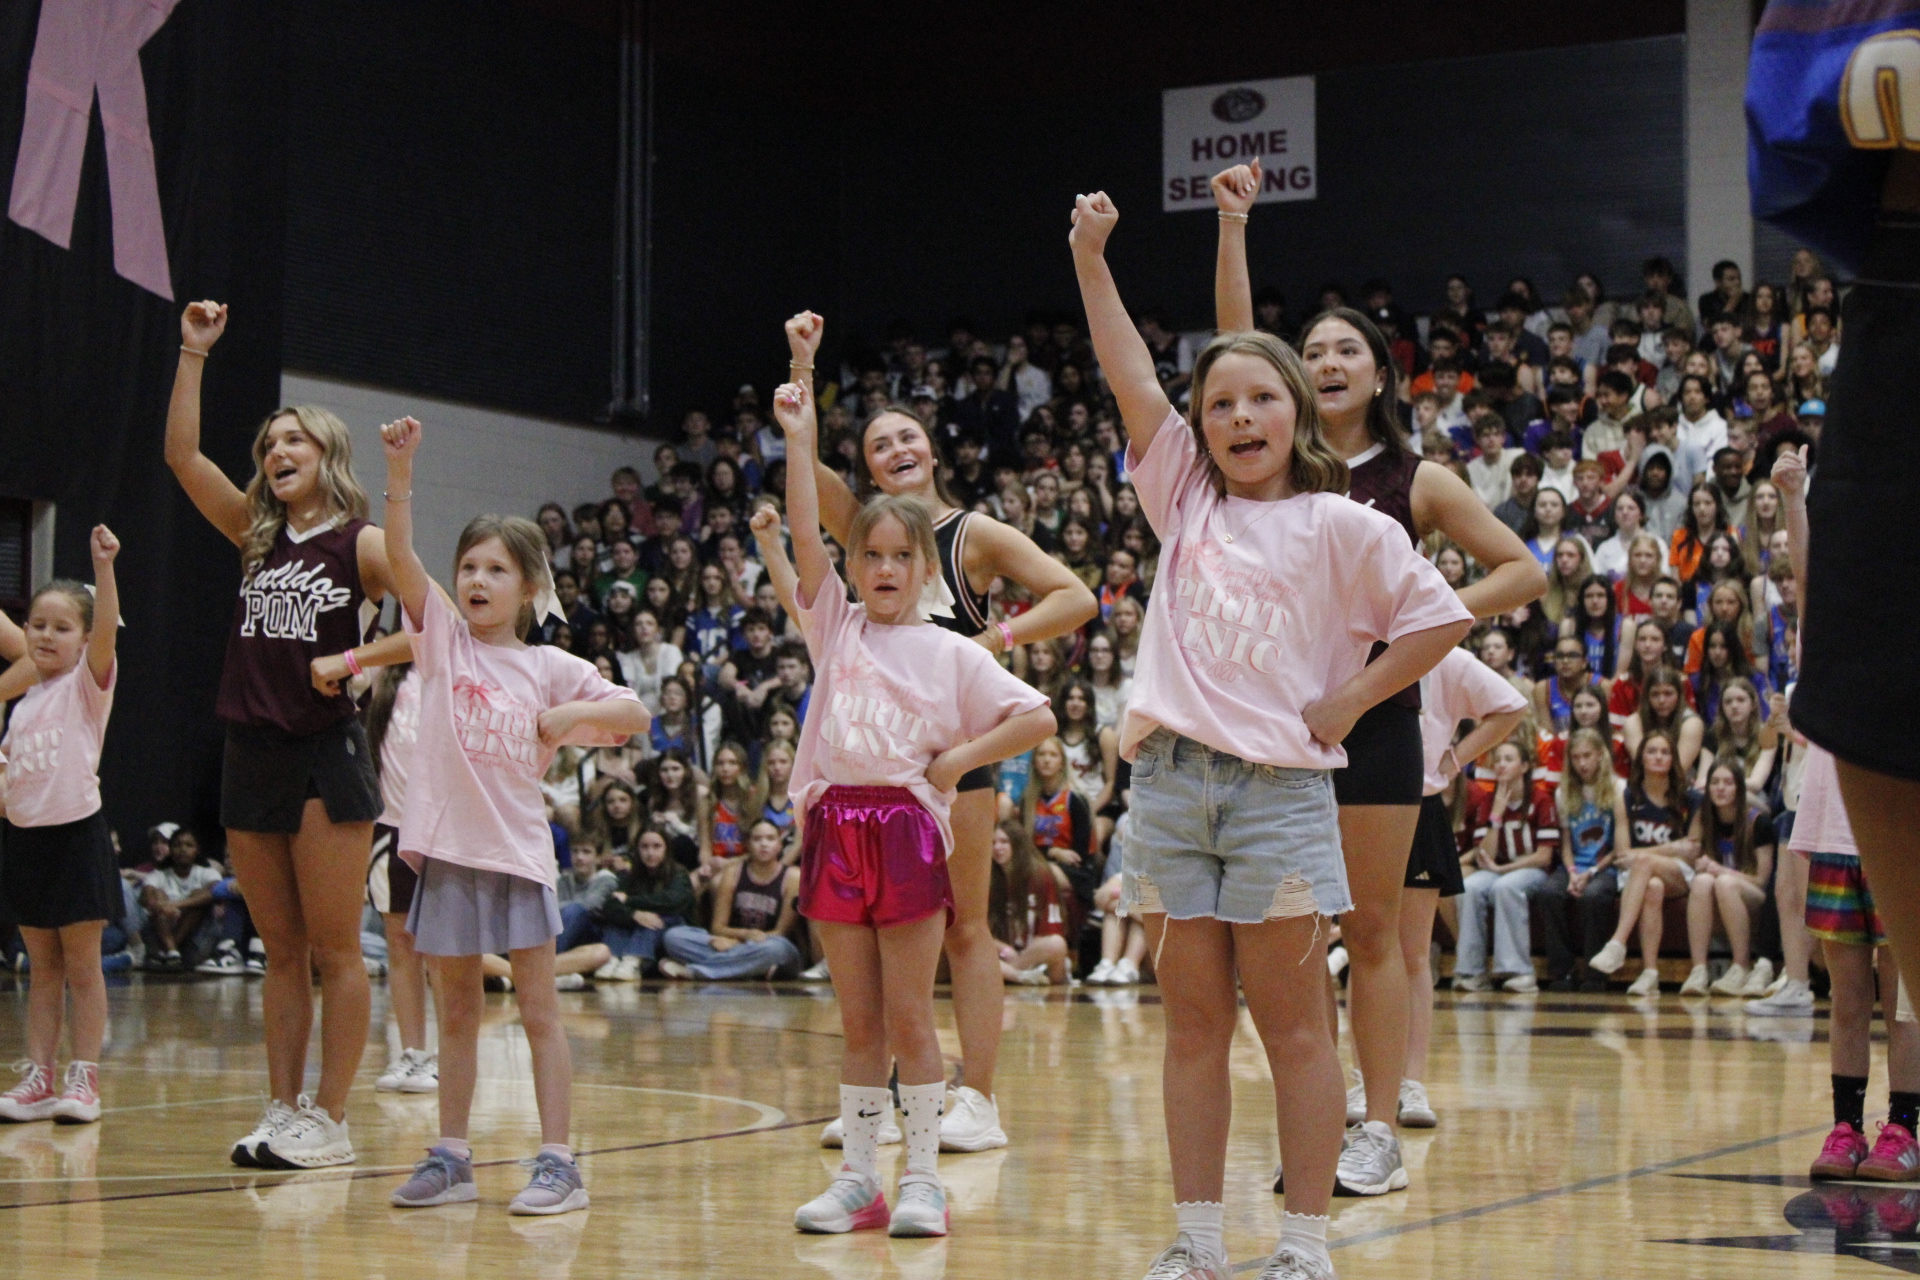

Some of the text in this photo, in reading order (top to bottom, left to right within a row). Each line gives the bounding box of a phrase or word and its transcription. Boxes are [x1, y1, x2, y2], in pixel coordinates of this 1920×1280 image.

[1191, 129, 1288, 162] HOME
[1168, 166, 1312, 201] SENG
[241, 590, 325, 642] POM
